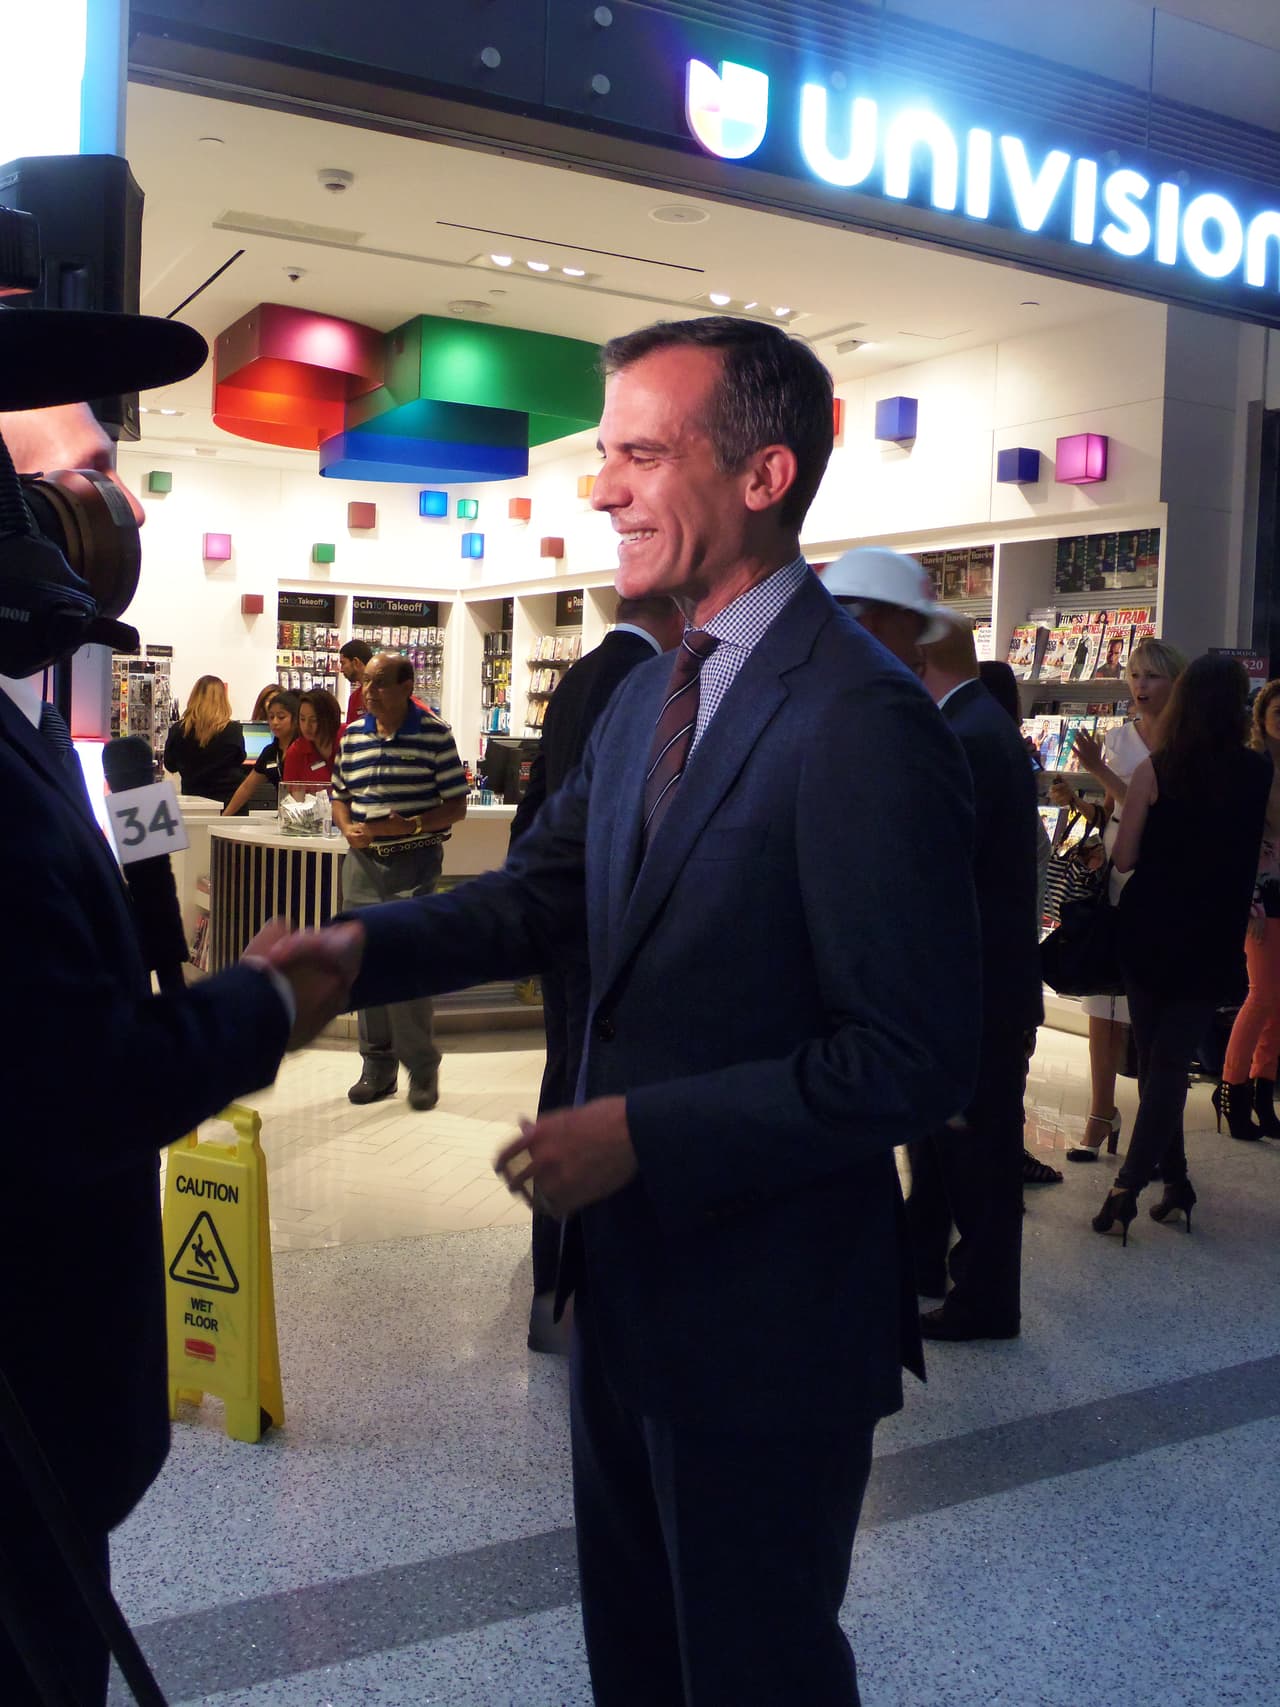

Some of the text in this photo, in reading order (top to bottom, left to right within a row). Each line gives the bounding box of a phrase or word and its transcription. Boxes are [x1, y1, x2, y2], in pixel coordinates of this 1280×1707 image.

[386, 600, 423, 612] Takeoff
[115, 799, 179, 847] 34
[176, 1175, 239, 1204] CAUTION
[190, 1296, 214, 1313] WET
[184, 1312, 218, 1332] FLOOR
